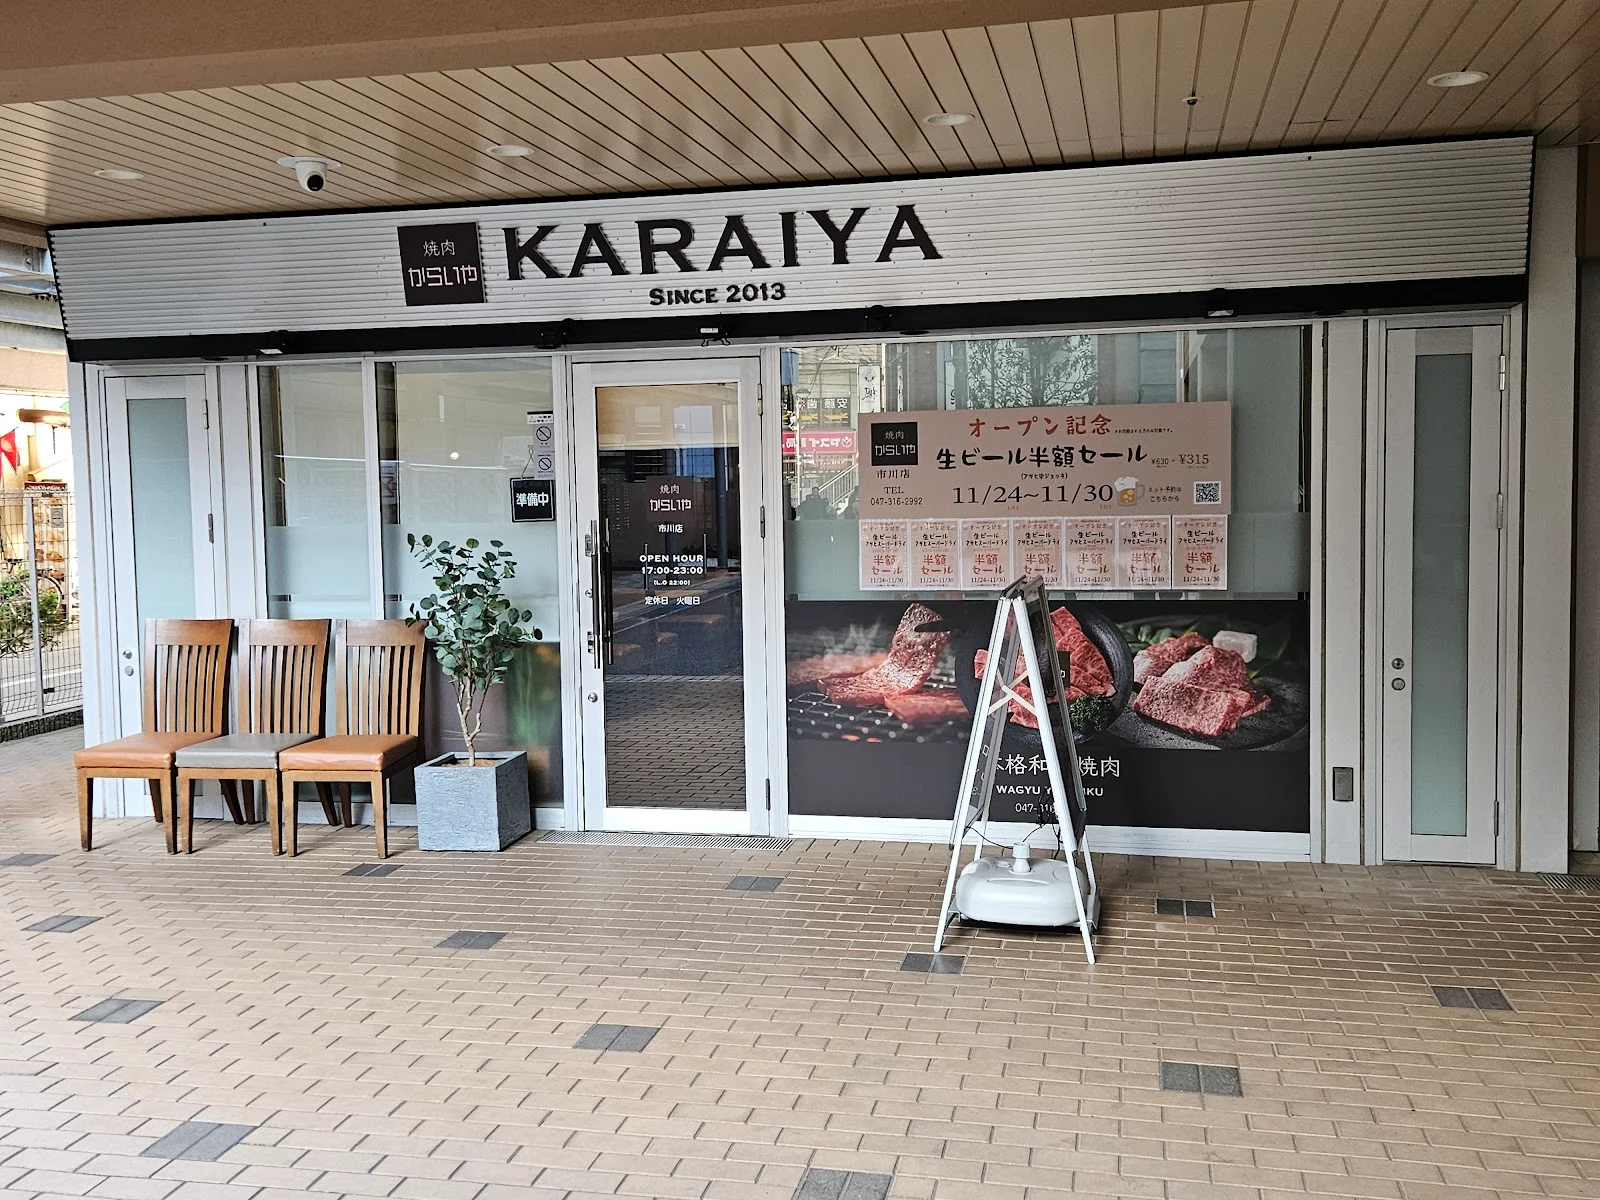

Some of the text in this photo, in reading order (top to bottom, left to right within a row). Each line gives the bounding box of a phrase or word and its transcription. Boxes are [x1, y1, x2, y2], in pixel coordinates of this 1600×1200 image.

[423, 239, 456, 257] 焼肉
[502, 204, 943, 281] KARAIYA
[408, 264, 478, 288] からいや
[649, 282, 787, 306] SINCE 2013
[969, 414, 1112, 438] オープン記念
[885, 430, 905, 440] 焼肉
[875, 444, 916, 456] からいや
[936, 445, 1148, 469] 生ビール半額セール
[1179, 454, 1209, 465] ¥315
[877, 469, 910, 479] 市川店
[660, 484, 680, 495] 焼肉
[884, 486, 904, 495] TEL
[515, 492, 549, 507] 準備中
[870, 497, 923, 506] 047-316-2992
[649, 499, 692, 512] からいや
[658, 524, 683, 534] 市川店
[639, 554, 704, 563] OPEN HOUR
[874, 554, 896, 566] 半額
[924, 554, 946, 566] 半額
[974, 554, 998, 565] 半額
[1026, 553, 1050, 564] 半額
[1078, 553, 1103, 564] 半額
[1132, 552, 1156, 564] 半額
[1187, 552, 1213, 564] 半額
[641, 566, 704, 575] 17:00-23:00
[872, 566, 902, 575] セール
[921, 566, 953, 575] セール
[972, 565, 1004, 574] セール
[1024, 565, 1056, 574] セール
[1076, 564, 1110, 574] セール
[1130, 564, 1163, 574] セール
[1185, 564, 1220, 574] セール
[644, 596, 701, 606] 定休日 火曜日
[995, 753, 1120, 778] 格和焼肉
[995, 785, 1041, 795] WAGYU
